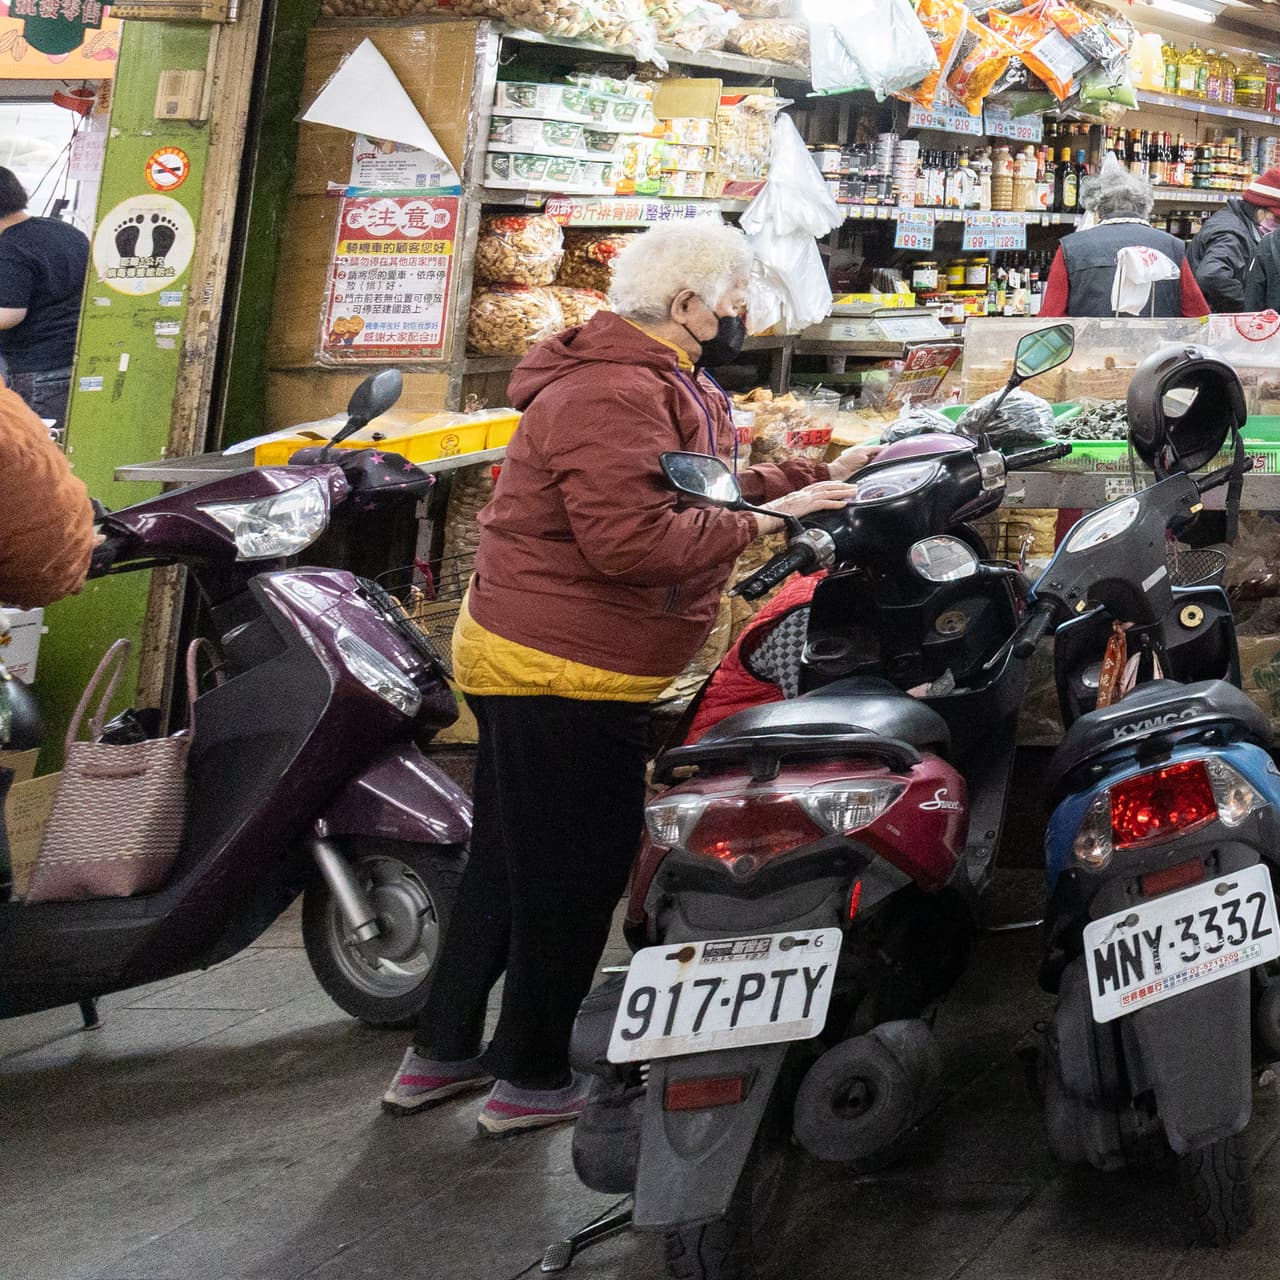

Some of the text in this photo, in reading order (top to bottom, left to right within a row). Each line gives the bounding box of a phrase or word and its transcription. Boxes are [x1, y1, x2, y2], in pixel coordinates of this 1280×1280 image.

[346, 242, 446, 254] 騎機車的顧客您好
